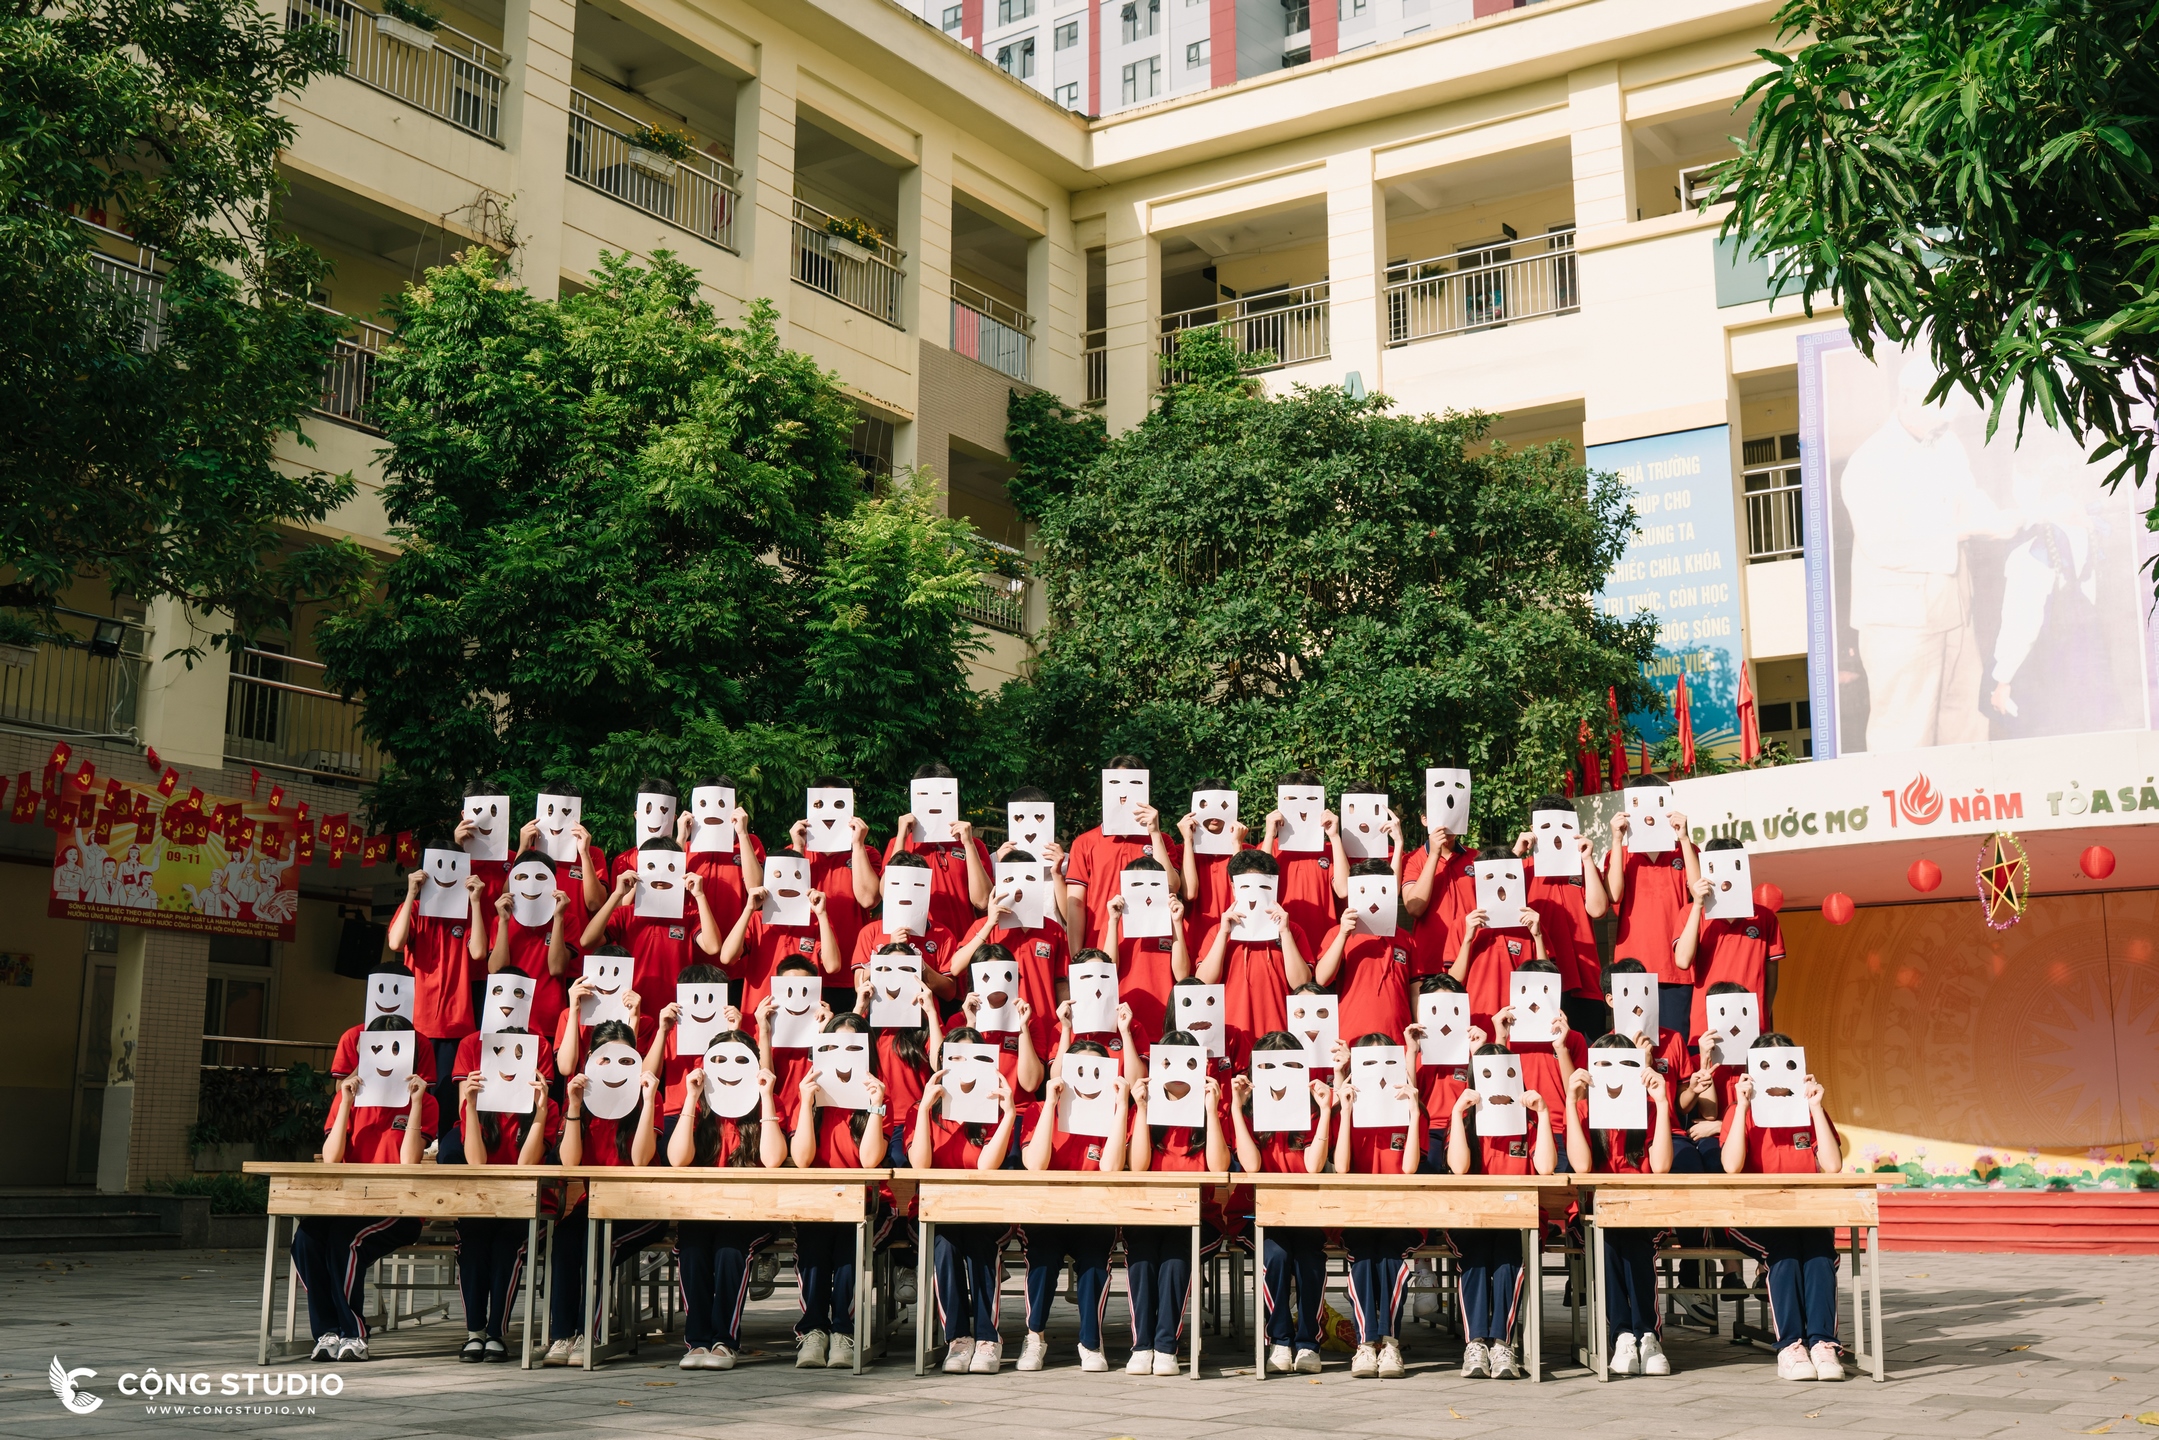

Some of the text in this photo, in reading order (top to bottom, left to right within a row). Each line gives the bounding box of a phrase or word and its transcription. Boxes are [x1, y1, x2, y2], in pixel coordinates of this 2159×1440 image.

[1647, 454, 1701, 481] TRƯỜNG
[1664, 489, 1691, 511] CHO
[1678, 521, 1695, 541] TA
[1650, 554, 1681, 579] CHÌA
[1684, 548, 1721, 574] KHÓA
[1603, 582, 1729, 617] TRI THỨC, CÒN HỌC
[1692, 611, 1731, 640] SỐNG
[1684, 648, 1715, 676] VIỆC
[1762, 806, 1820, 841] ƯỚC
[1824, 805, 1870, 836] MƠ
[1949, 788, 2024, 824] NĂM
[2046, 780, 2115, 817] TỎA
[166, 850, 200, 865] 09-11
[68, 902, 87, 911] SỐNG
[96, 905, 110, 913] LÀM
[110, 906, 125, 915] VIỆC
[125, 909, 142, 917] THEO
[143, 910, 157, 918] HIẾN
[175, 913, 191, 921] PHÁP
[191, 915, 206, 923] LUẬT
[215, 918, 231, 926] HÀNH
[231, 920, 248, 928] ĐỘNG
[264, 923, 279, 931] THỰC
[123, 915, 140, 923] PHÁP
[140, 917, 155, 925] LUẬT
[173, 921, 191, 929] CỘNG
[223, 925, 236, 933] CHỦ
[254, 929, 266, 937] VIỆT
